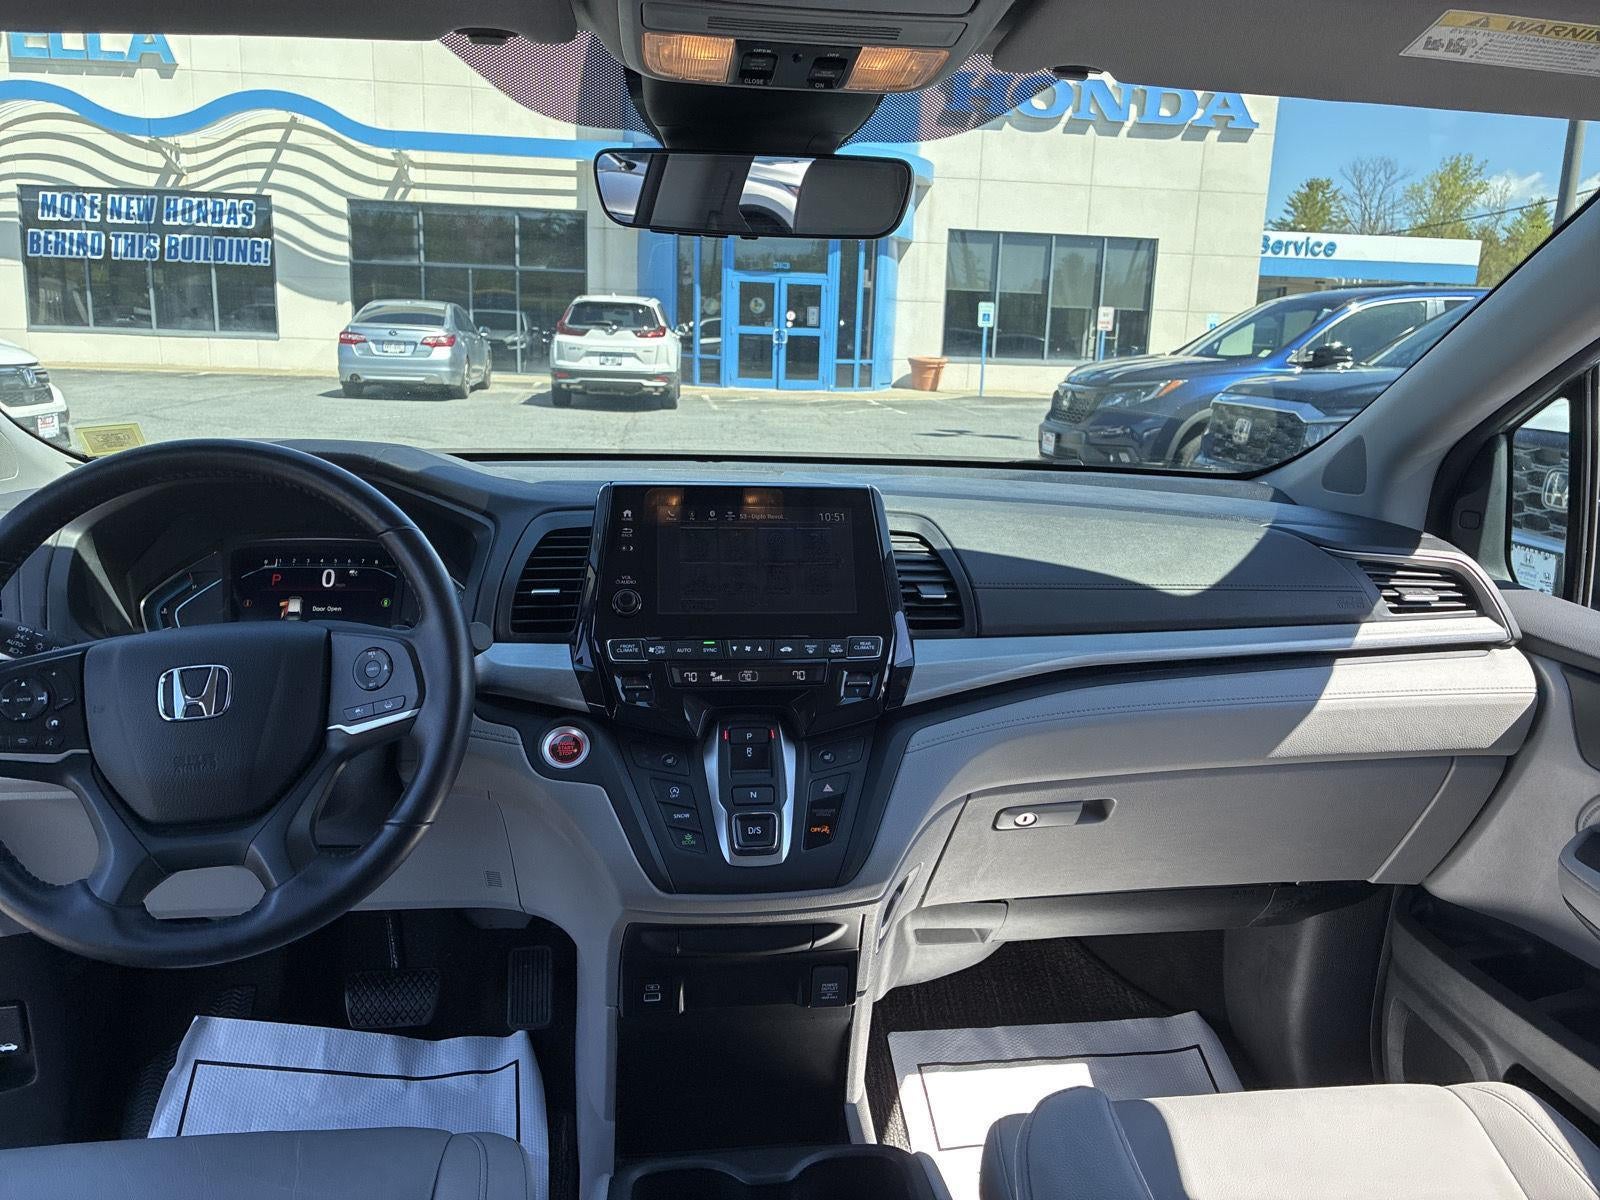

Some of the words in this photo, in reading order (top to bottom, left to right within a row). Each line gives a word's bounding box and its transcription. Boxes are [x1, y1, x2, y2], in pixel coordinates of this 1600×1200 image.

[946, 70, 1260, 129] HONDA
[38, 192, 100, 222] MORE
[107, 194, 157, 223] NEW
[163, 196, 255, 229] HONDAS
[28, 229, 105, 259] BEHIND
[110, 232, 160, 260] THIS
[165, 234, 272, 266] BUILDING!
[1261, 234, 1337, 257] Service
[819, 513, 845, 522] 10:51
[272, 574, 282, 586] P
[321, 569, 336, 588] 0
[684, 672, 697, 682] 70
[792, 670, 805, 680] 70
[746, 732, 752, 740] P
[747, 826, 761, 835] D/S
